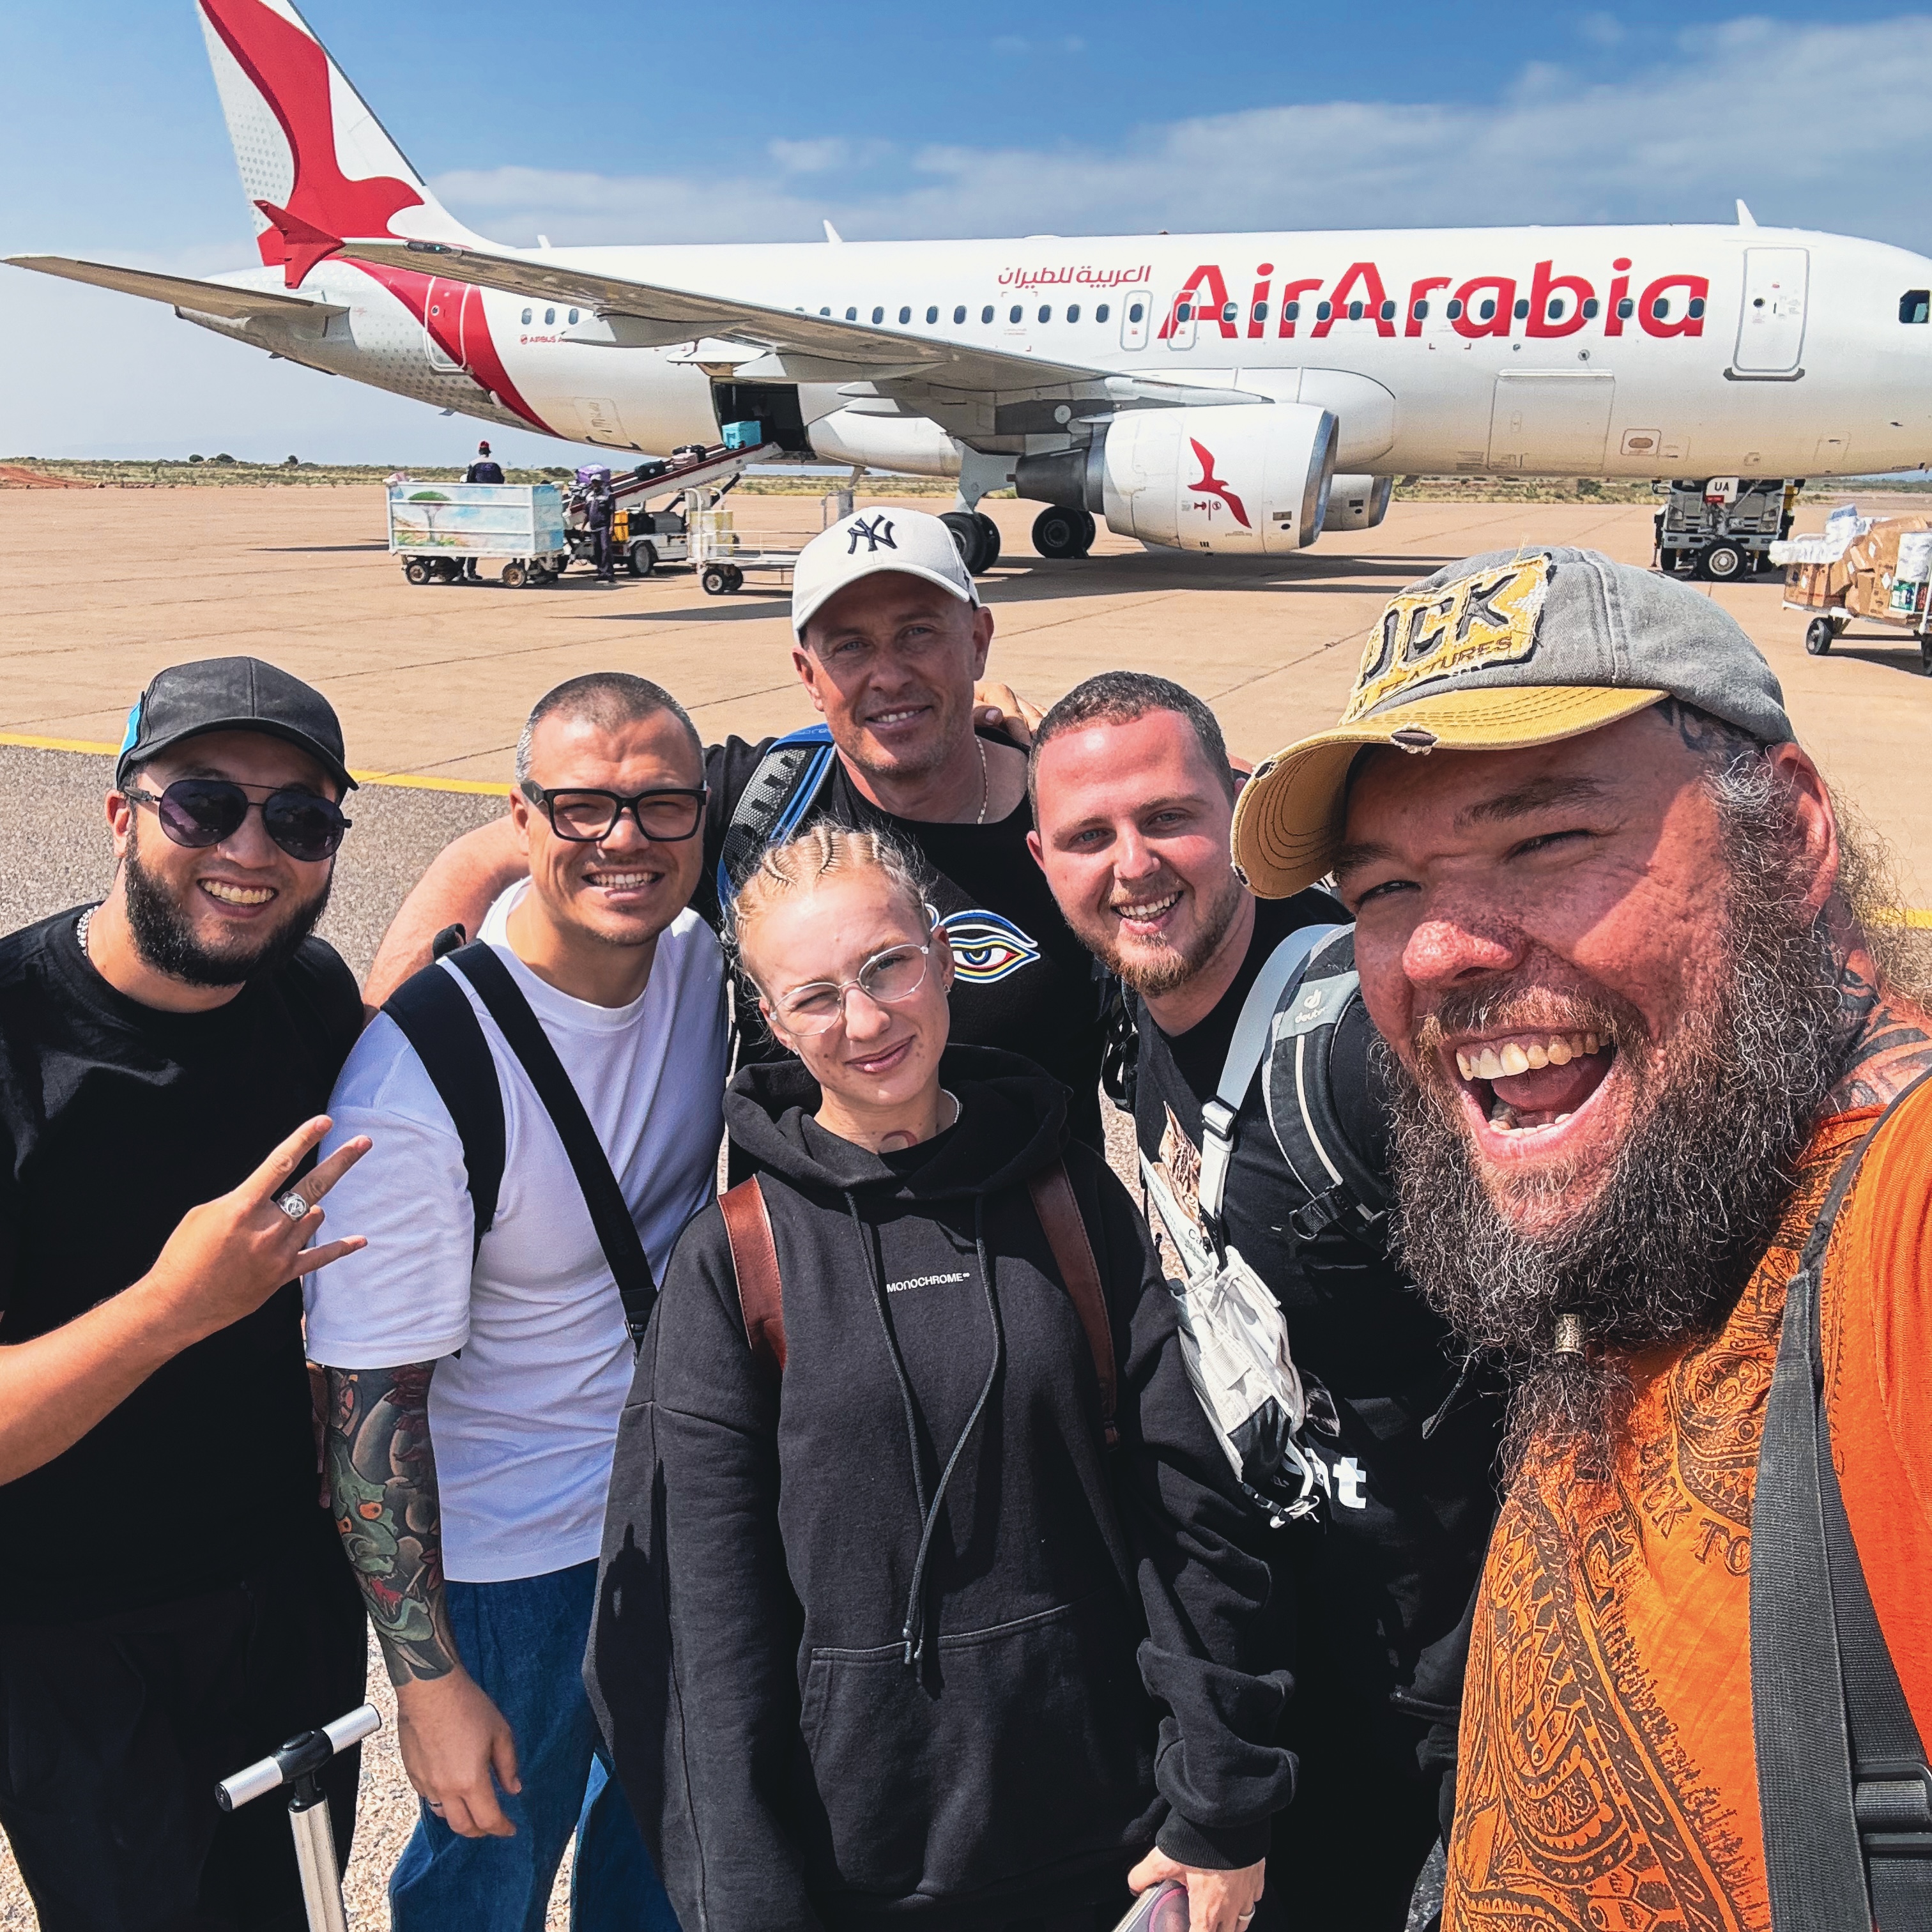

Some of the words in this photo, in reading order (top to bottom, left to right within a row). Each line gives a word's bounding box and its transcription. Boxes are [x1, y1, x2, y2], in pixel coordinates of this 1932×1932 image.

[998, 267, 1075, 289] للطيران
[1075, 264, 1151, 288] العربية
[1158, 257, 1710, 339] AirArabia
[1714, 482, 1729, 491] UA
[847, 514, 898, 555] NY
[886, 1273, 965, 1293] MONOCHROME
[1694, 1517, 1751, 1577] TO
